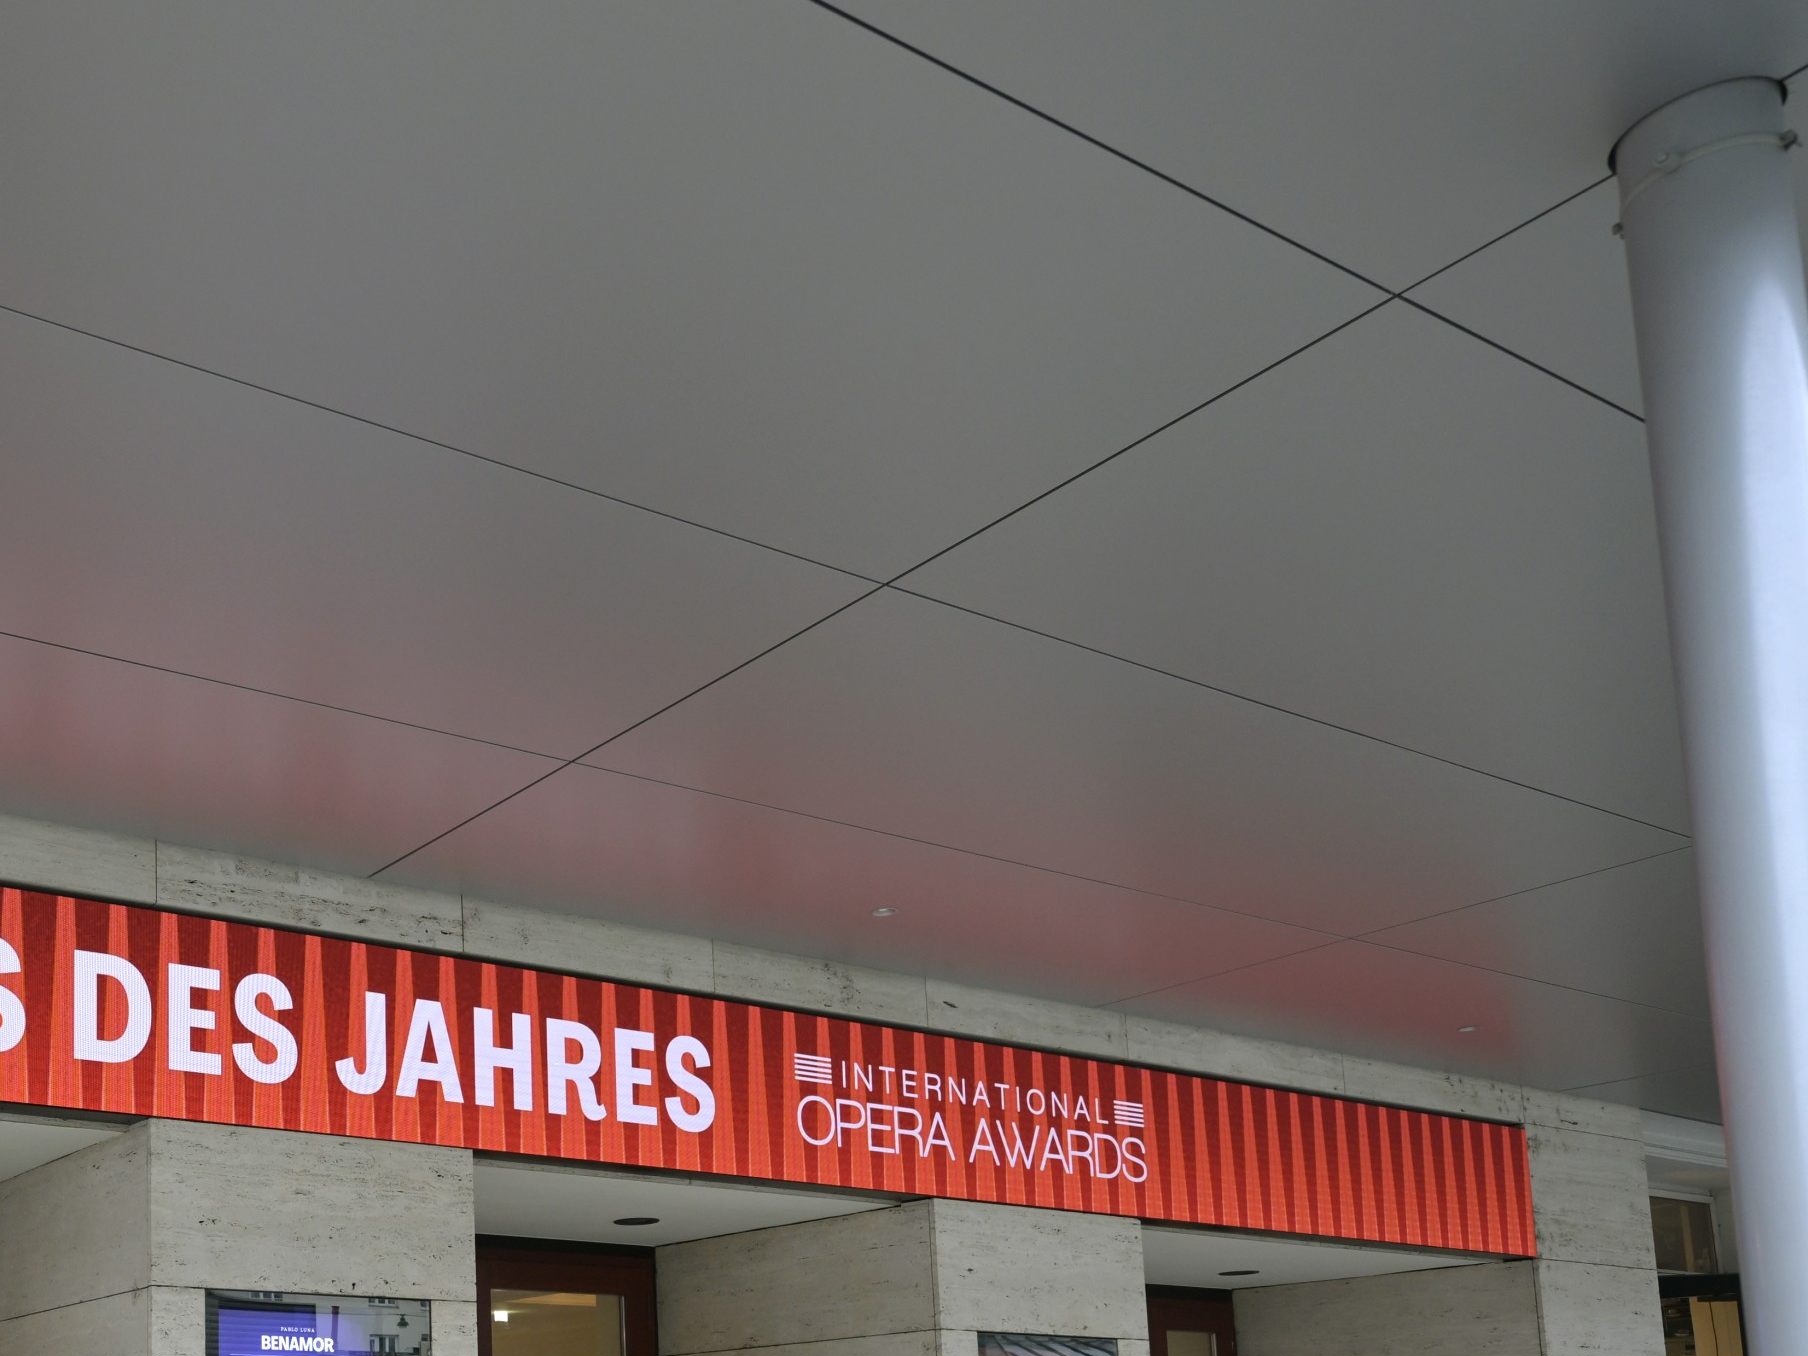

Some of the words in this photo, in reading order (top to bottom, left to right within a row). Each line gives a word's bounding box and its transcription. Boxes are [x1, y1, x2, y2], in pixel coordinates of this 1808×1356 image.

[73, 949, 299, 1084] DES
[334, 991, 717, 1133] JAHRES
[841, 1060, 1110, 1125] INTERNATIONAL
[797, 1095, 956, 1161] OPERA
[969, 1117, 1148, 1183] AWARDS
[261, 1334, 334, 1353] BENAMOR
